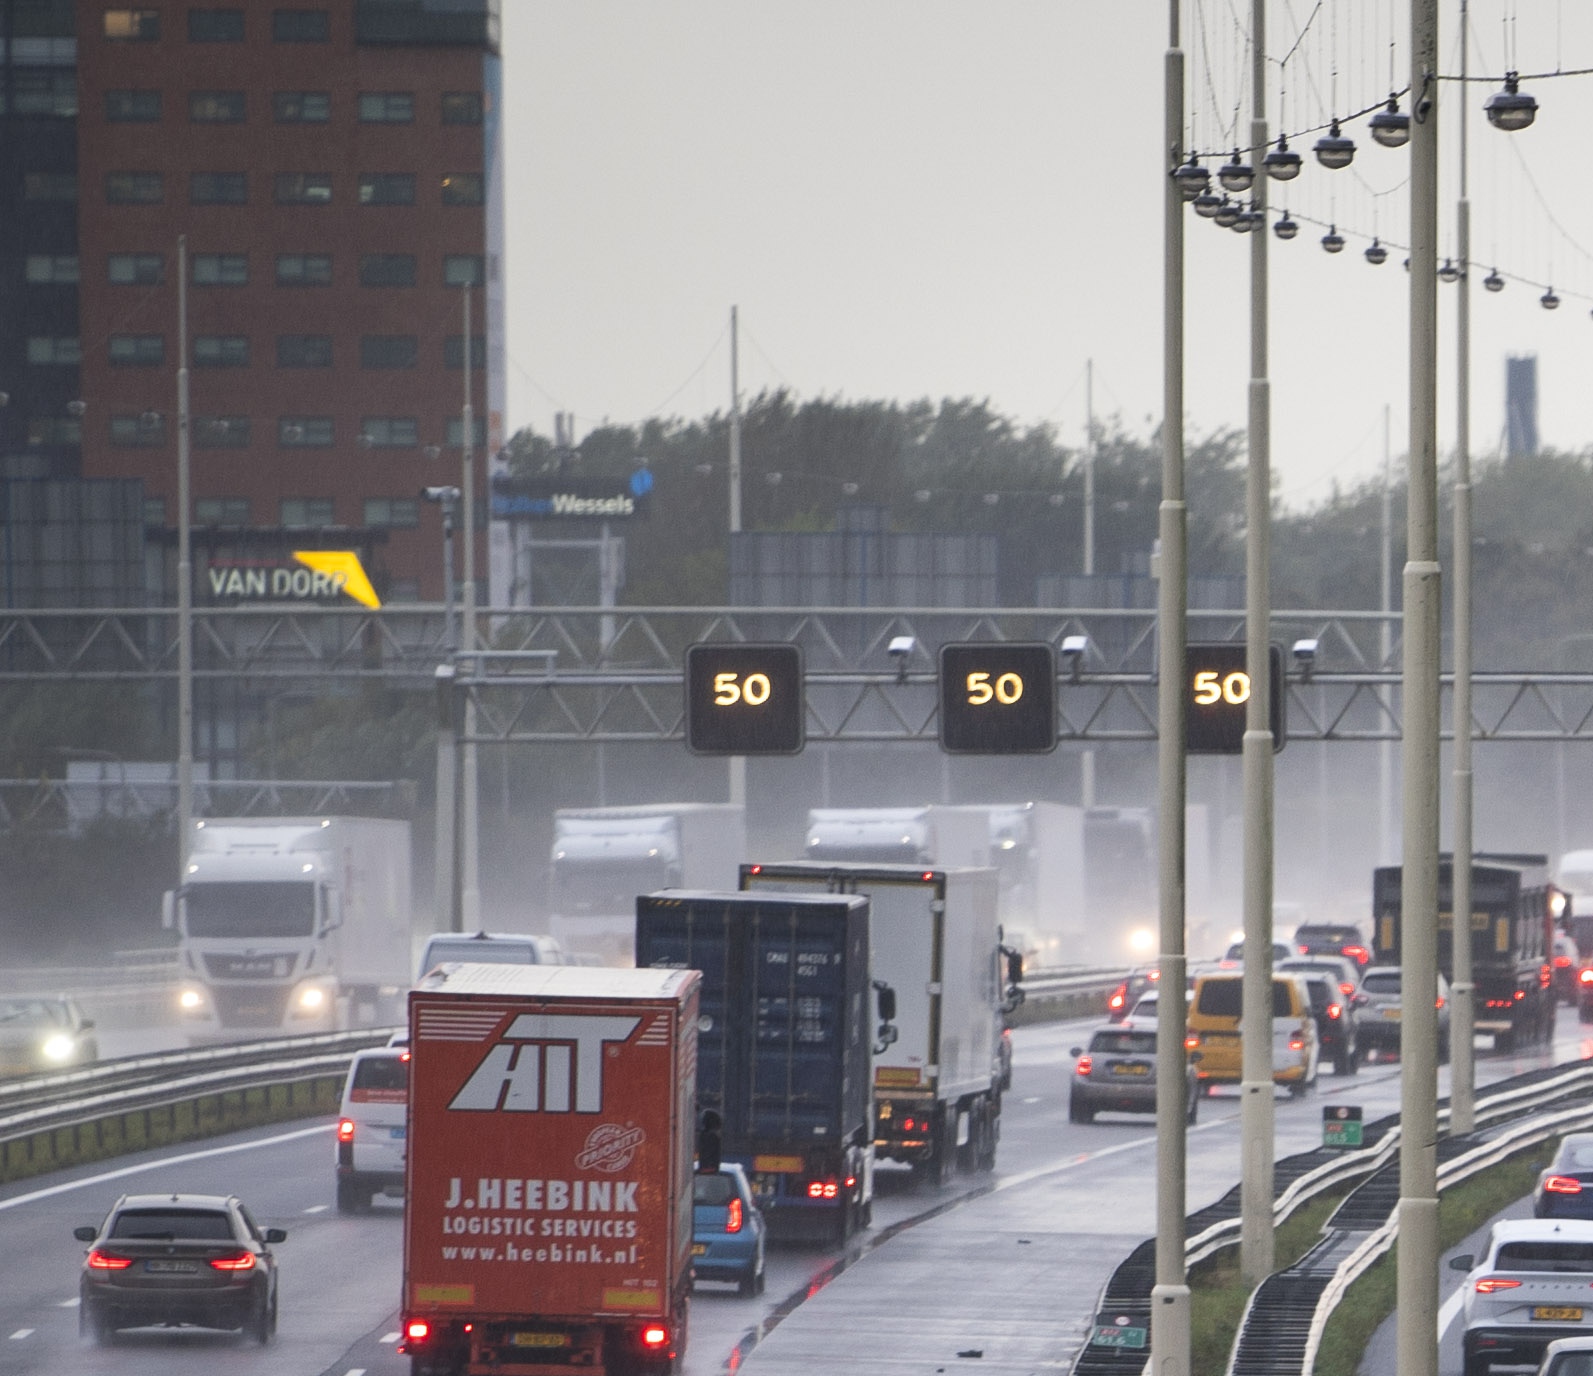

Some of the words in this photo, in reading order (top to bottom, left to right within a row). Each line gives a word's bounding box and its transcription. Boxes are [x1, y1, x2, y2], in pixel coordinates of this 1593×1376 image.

[208, 568, 266, 595] VAN
[272, 570, 348, 596] DORP
[714, 672, 771, 706] 50
[966, 672, 1023, 705] 50
[1194, 671, 1251, 705] 50
[445, 1177, 639, 1213] J.HEEBINK
[442, 1216, 535, 1236] LOGISTIC
[541, 1217, 637, 1239] SERVICES
[441, 1242, 638, 1264] www.heebink.nl
